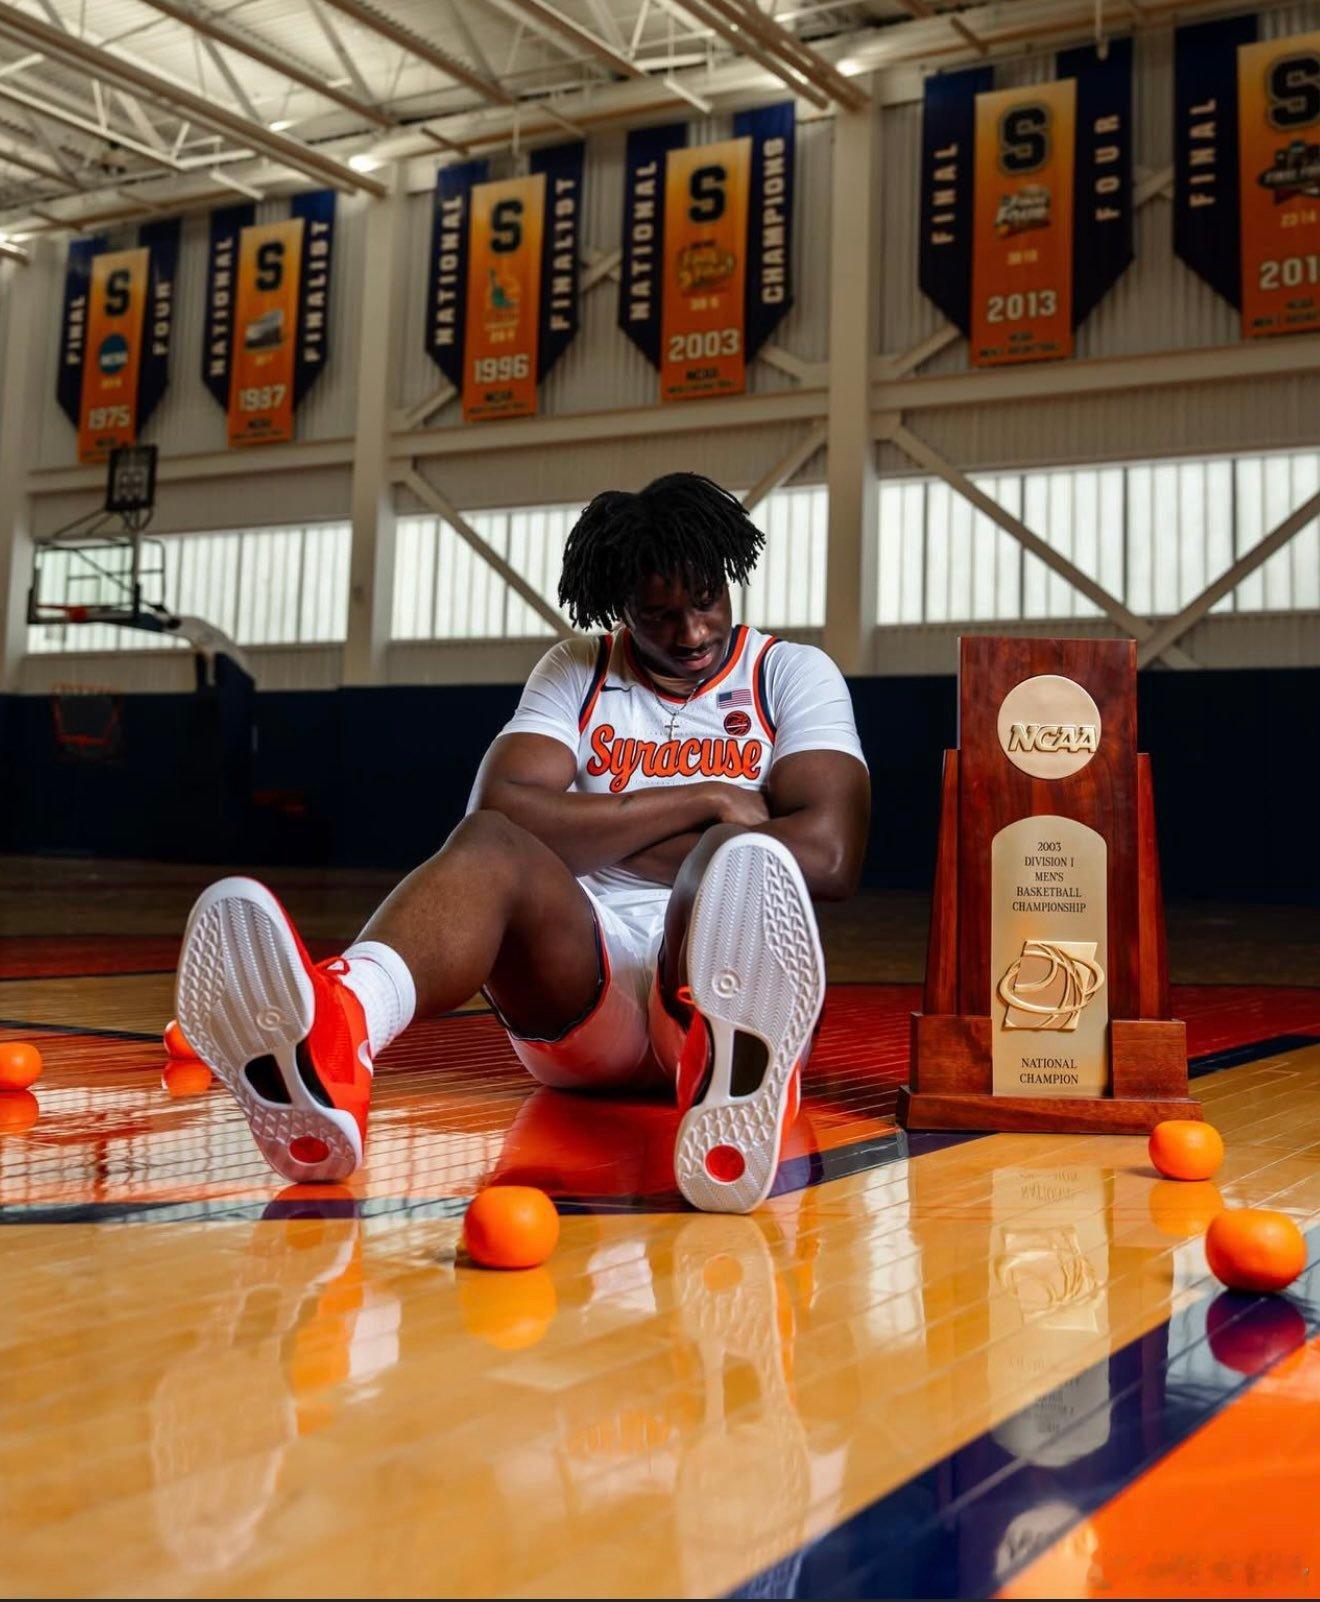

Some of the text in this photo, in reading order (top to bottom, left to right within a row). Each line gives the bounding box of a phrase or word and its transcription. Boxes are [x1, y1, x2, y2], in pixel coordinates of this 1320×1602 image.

[1268, 53, 1320, 132] S
[1001, 102, 1051, 174] S
[1190, 99, 1216, 208] FINAL
[688, 165, 728, 224] S
[932, 143, 959, 244] FINAL
[1094, 115, 1120, 220] FOUR
[490, 200, 524, 254] S
[629, 161, 658, 321] NATIONAL
[762, 138, 785, 305] CHAMPIONS
[255, 241, 285, 292] S
[435, 195, 462, 345] NATIONAL
[551, 178, 575, 330] FINALIST
[1259, 255, 1319, 291] 201
[103, 268, 131, 318] S
[153, 282, 171, 356] FOUR
[210, 236, 233, 377] NATIONAL
[304, 222, 329, 362] FINALIST
[987, 290, 1057, 323] 2013
[66, 296, 86, 365] FINAL
[669, 328, 739, 362] 2003
[473, 353, 530, 384] 1996
[88, 405, 130, 430] 1975
[586, 723, 762, 793] Syracuse
[1007, 723, 1097, 753] NCAA
[1024, 856, 1068, 867] DIVISION
[1037, 842, 1062, 852] 2003
[1016, 887, 1082, 898] BASKETBALL
[1035, 872, 1064, 882] MEN'S
[1012, 901, 1087, 913] CHAMPIONSHIP
[1019, 1073, 1079, 1085] CHAMPION
[1021, 1058, 1078, 1069] NATIONAL
